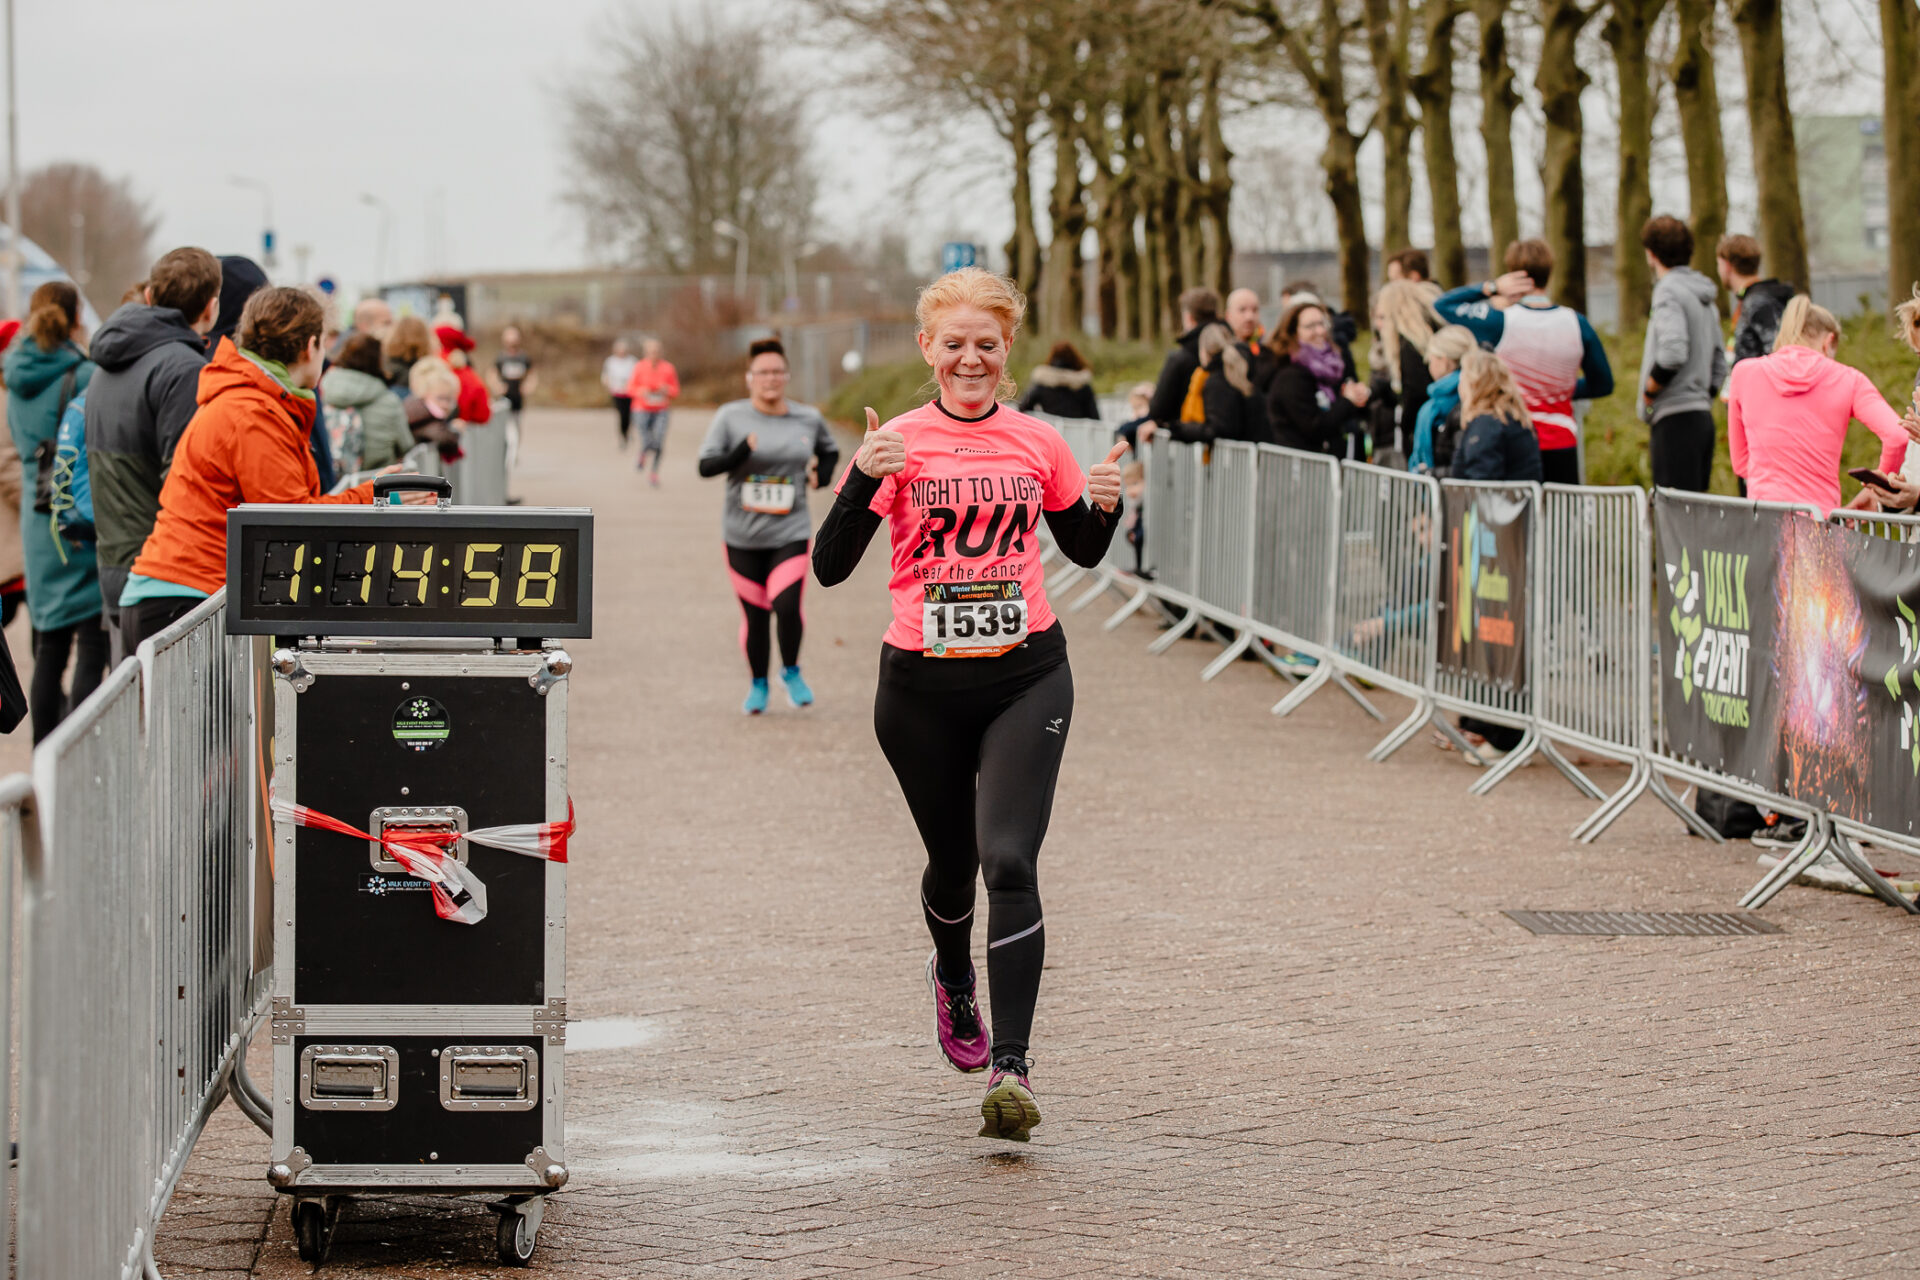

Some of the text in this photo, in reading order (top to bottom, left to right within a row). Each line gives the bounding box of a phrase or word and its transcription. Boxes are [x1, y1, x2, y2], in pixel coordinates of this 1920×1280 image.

[911, 478, 963, 508] NIGHT
[968, 477, 994, 503] TO
[912, 503, 1041, 558] RUN
[289, 544, 562, 607] 1:14:58
[913, 564, 942, 580] Beat
[949, 564, 974, 580] the
[950, 585, 971, 593] Winter
[957, 592, 994, 600] Leeuwarden
[1702, 549, 1750, 631] VALK
[931, 603, 1021, 638] 1539
[1693, 627, 1750, 696] EVENT
